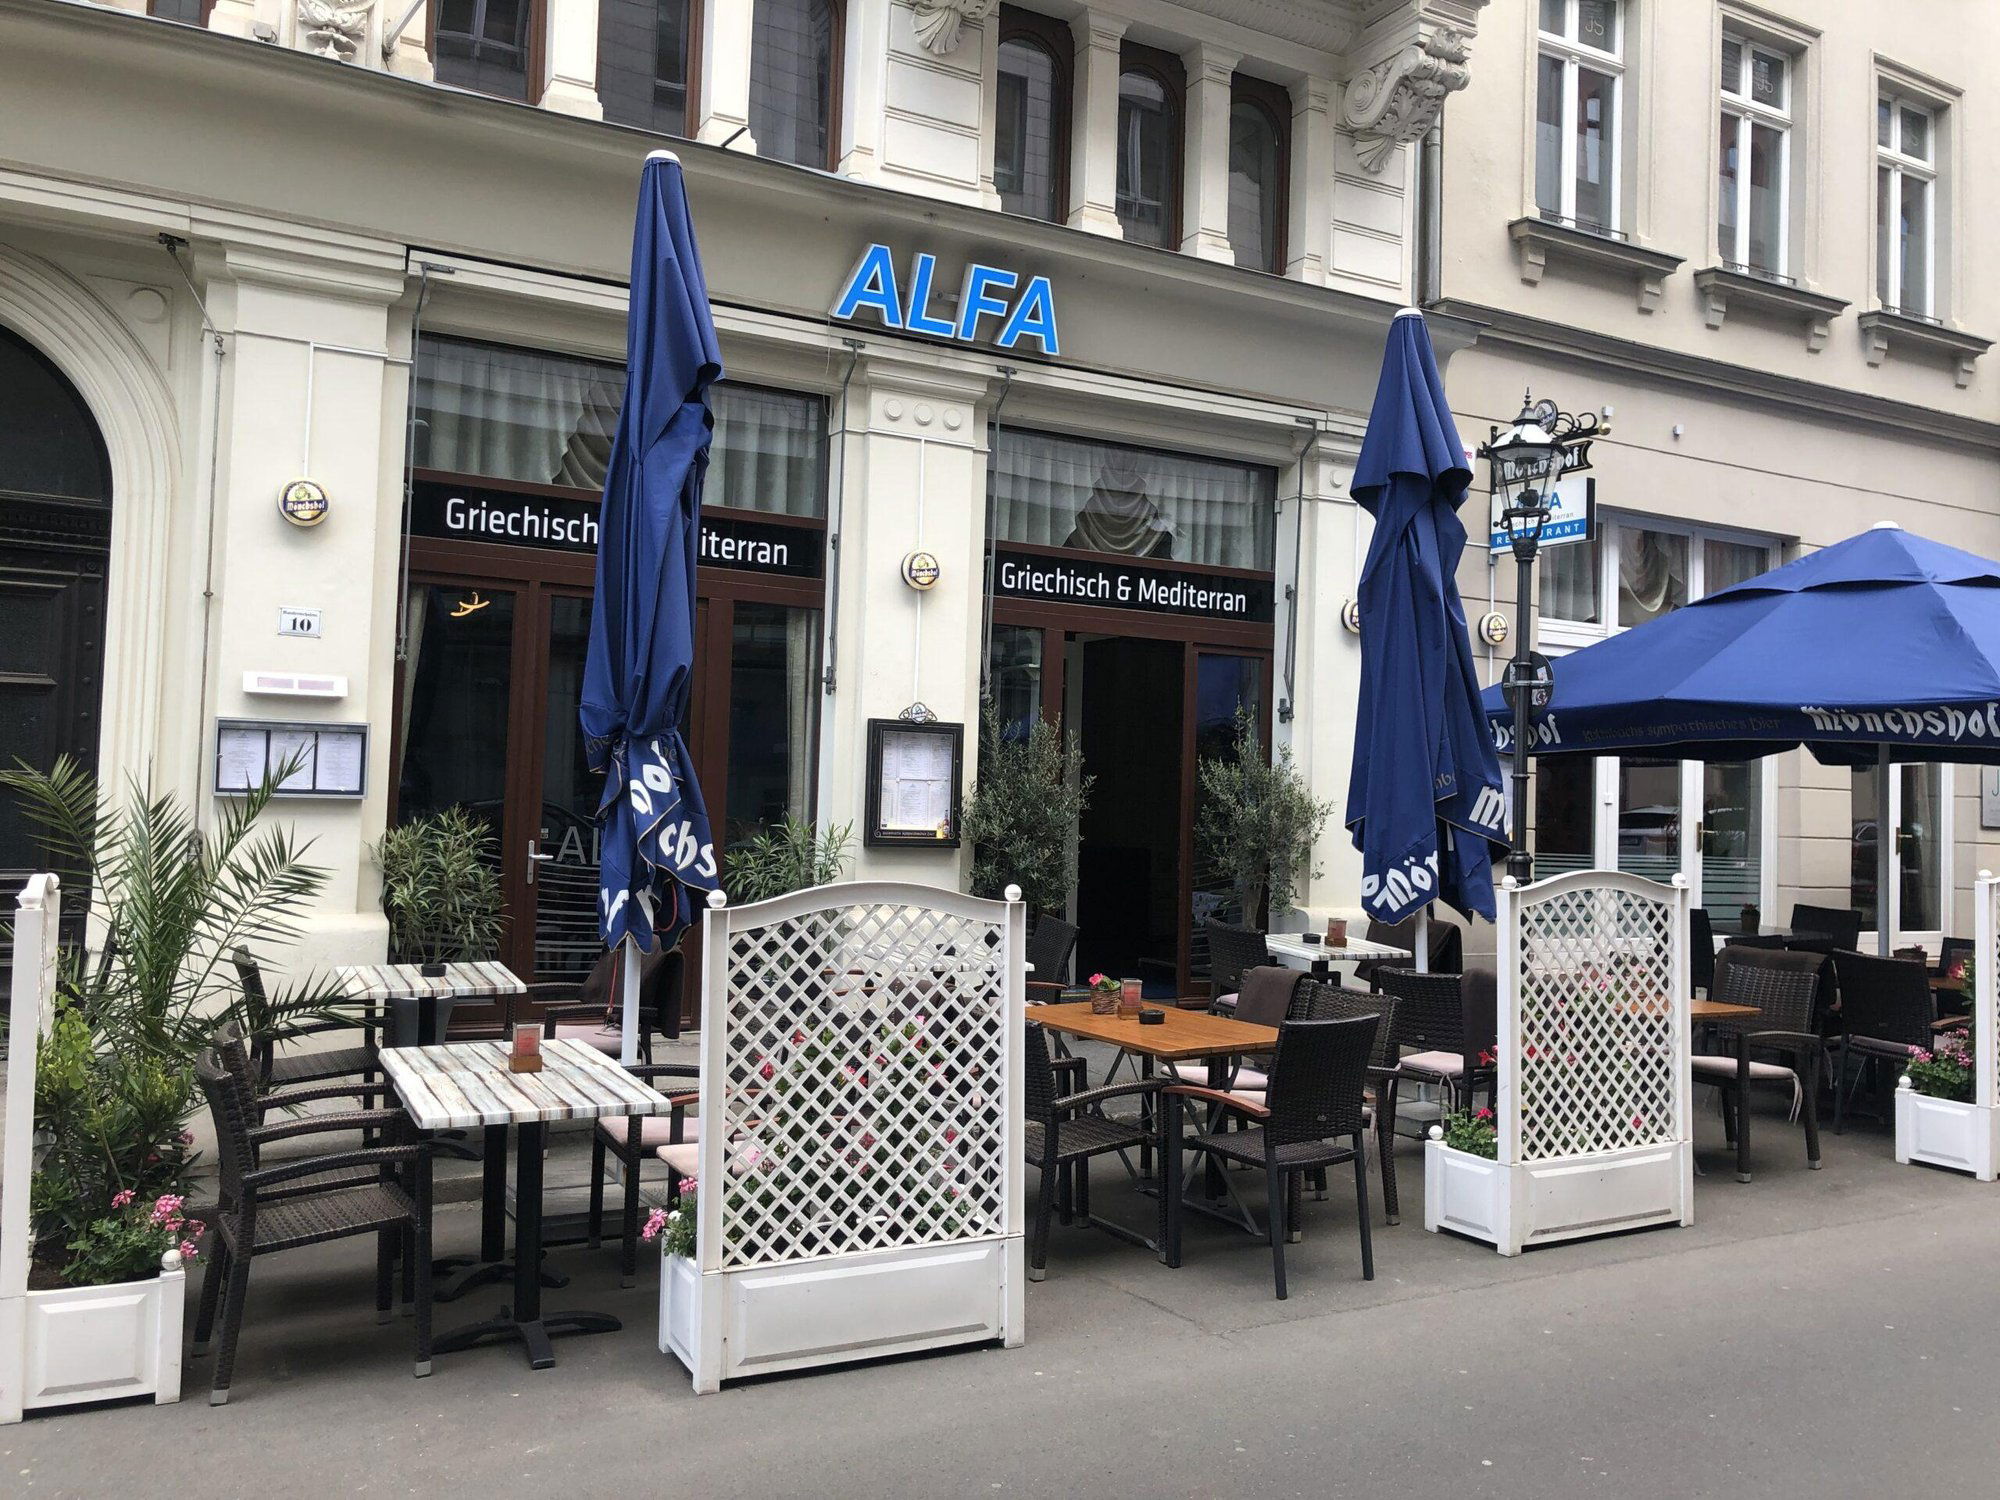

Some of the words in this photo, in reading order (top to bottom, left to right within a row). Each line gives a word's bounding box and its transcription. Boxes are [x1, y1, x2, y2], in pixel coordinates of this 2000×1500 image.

[829, 242, 1060, 357] ALFA
[445, 497, 599, 544] Griechisch
[701, 527, 788, 566] iterran
[1001, 561, 1110, 599] Griechisch
[1117, 575, 1132, 601] &
[1139, 577, 1246, 612] Mediterran
[290, 617, 312, 632] 10
[1801, 702, 2000, 742] Mönchshof
[556, 825, 601, 865] AL
